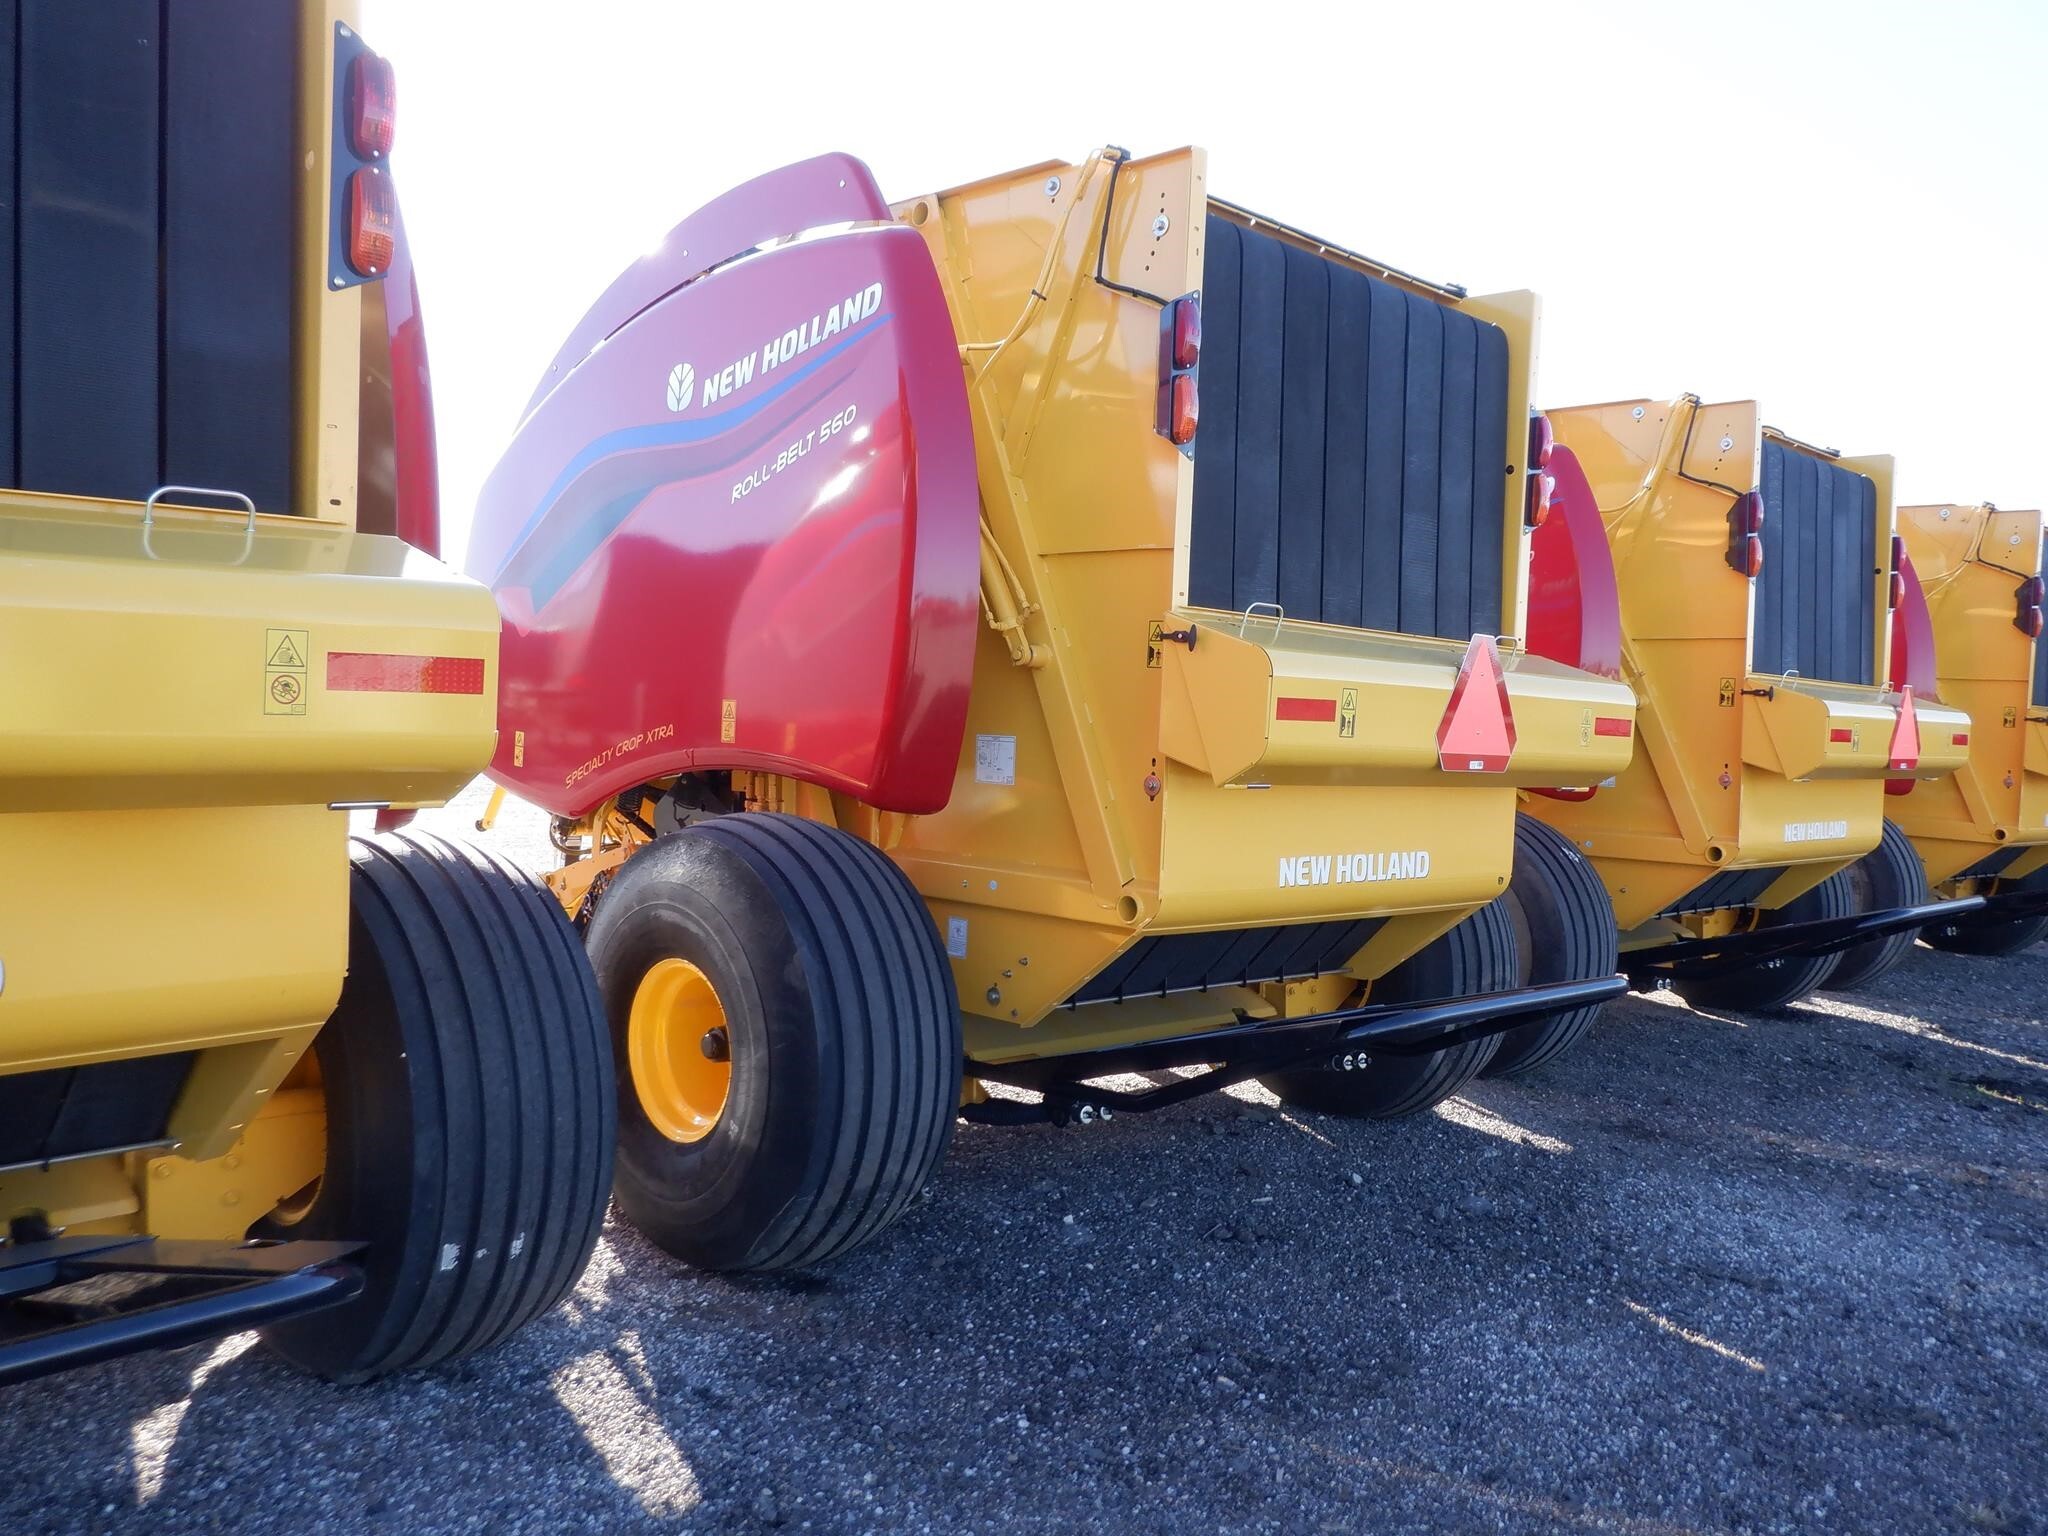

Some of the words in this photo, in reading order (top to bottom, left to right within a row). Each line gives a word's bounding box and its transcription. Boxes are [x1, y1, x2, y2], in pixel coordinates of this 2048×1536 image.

[702, 352, 757, 408] NEW
[761, 282, 883, 373] HOLLAND
[731, 430, 816, 504] ROLL-BELT
[819, 404, 857, 444] 560
[565, 748, 613, 789] SPECIALTY
[616, 734, 643, 757] CROP
[646, 724, 674, 744] XTRA
[1784, 824, 1806, 843] NEW
[1808, 820, 1847, 841] HOLLAND
[1279, 856, 1332, 888] NEW
[1336, 851, 1430, 884] HOLLAND
